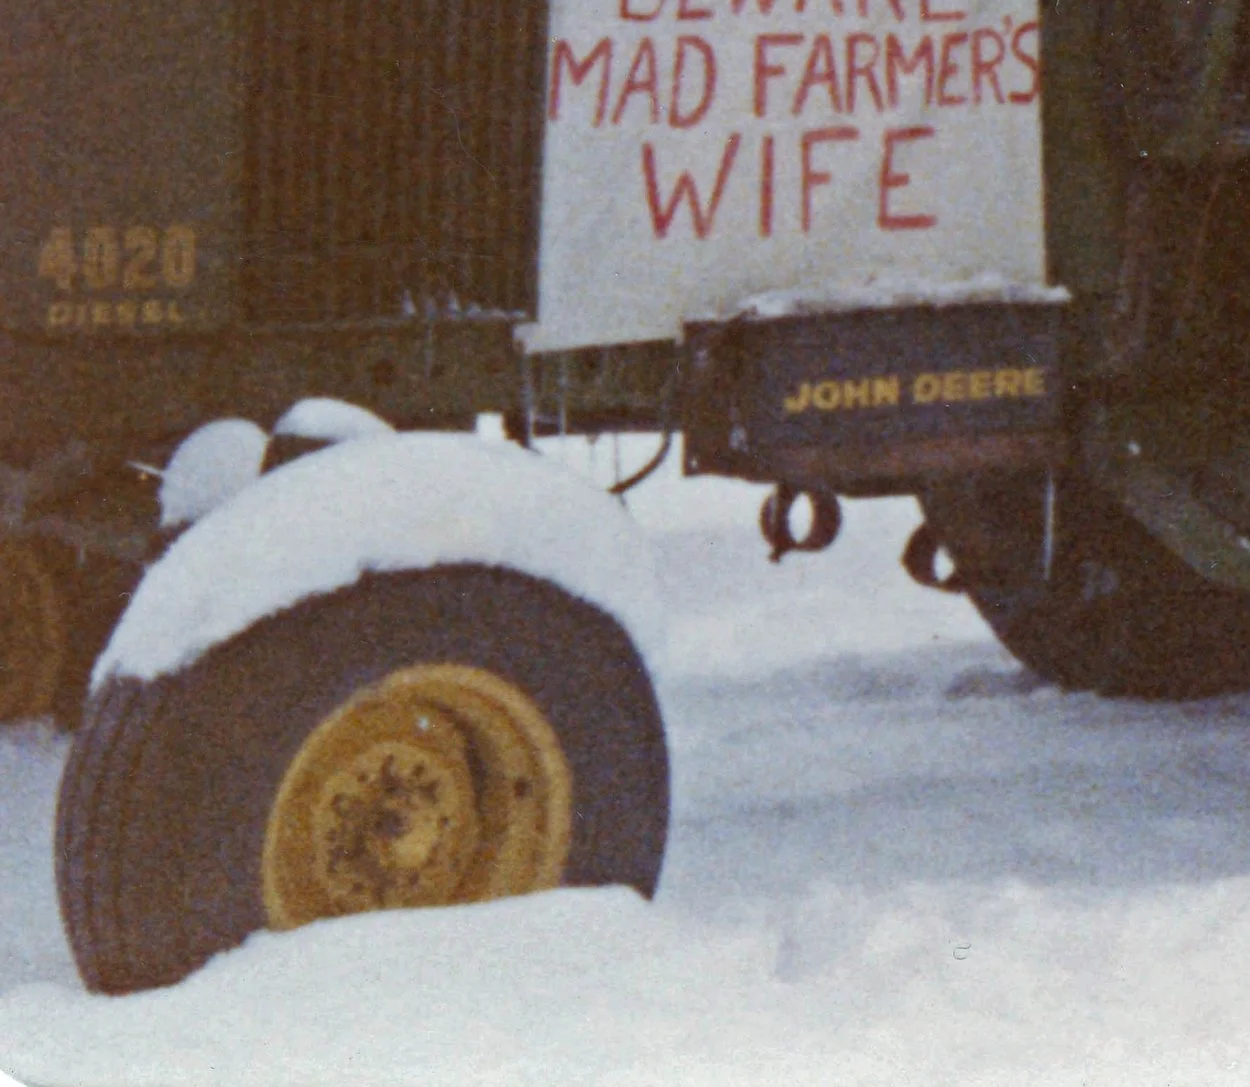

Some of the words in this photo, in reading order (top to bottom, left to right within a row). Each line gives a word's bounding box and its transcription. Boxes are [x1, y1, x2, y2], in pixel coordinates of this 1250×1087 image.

[549, 34, 717, 128] MAD
[751, 16, 1041, 118] FARMER'S
[641, 124, 938, 239] WIFE
[38, 226, 197, 290] 4020
[47, 302, 187, 327] DIESEL
[784, 375, 899, 413] JOHN
[912, 367, 1046, 405] DEERE
